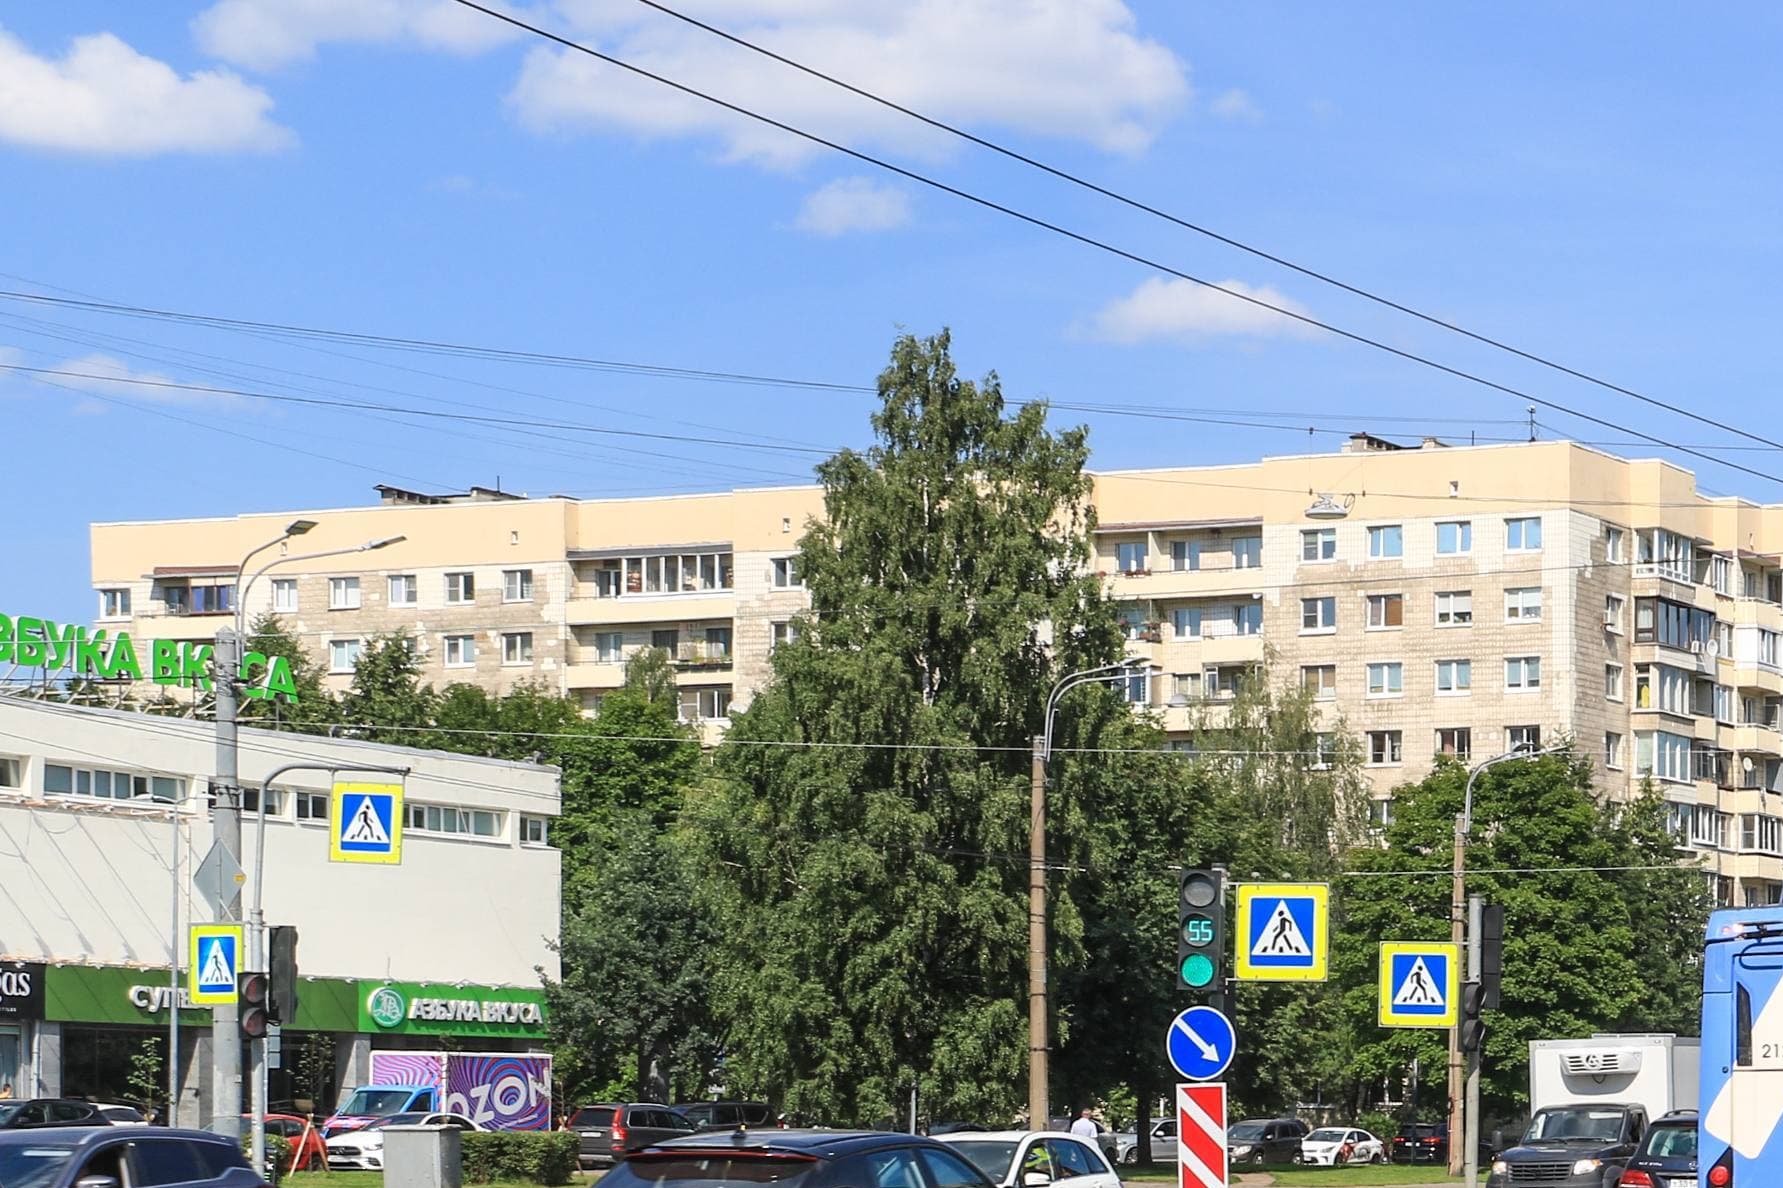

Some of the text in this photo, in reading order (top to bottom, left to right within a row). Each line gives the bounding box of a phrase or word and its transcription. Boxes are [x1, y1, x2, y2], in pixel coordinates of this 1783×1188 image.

[152, 639, 299, 704] ВКСА
[1188, 920, 1213, 941] 55
[409, 998, 544, 1025] АЗБУКА ВКУСА
